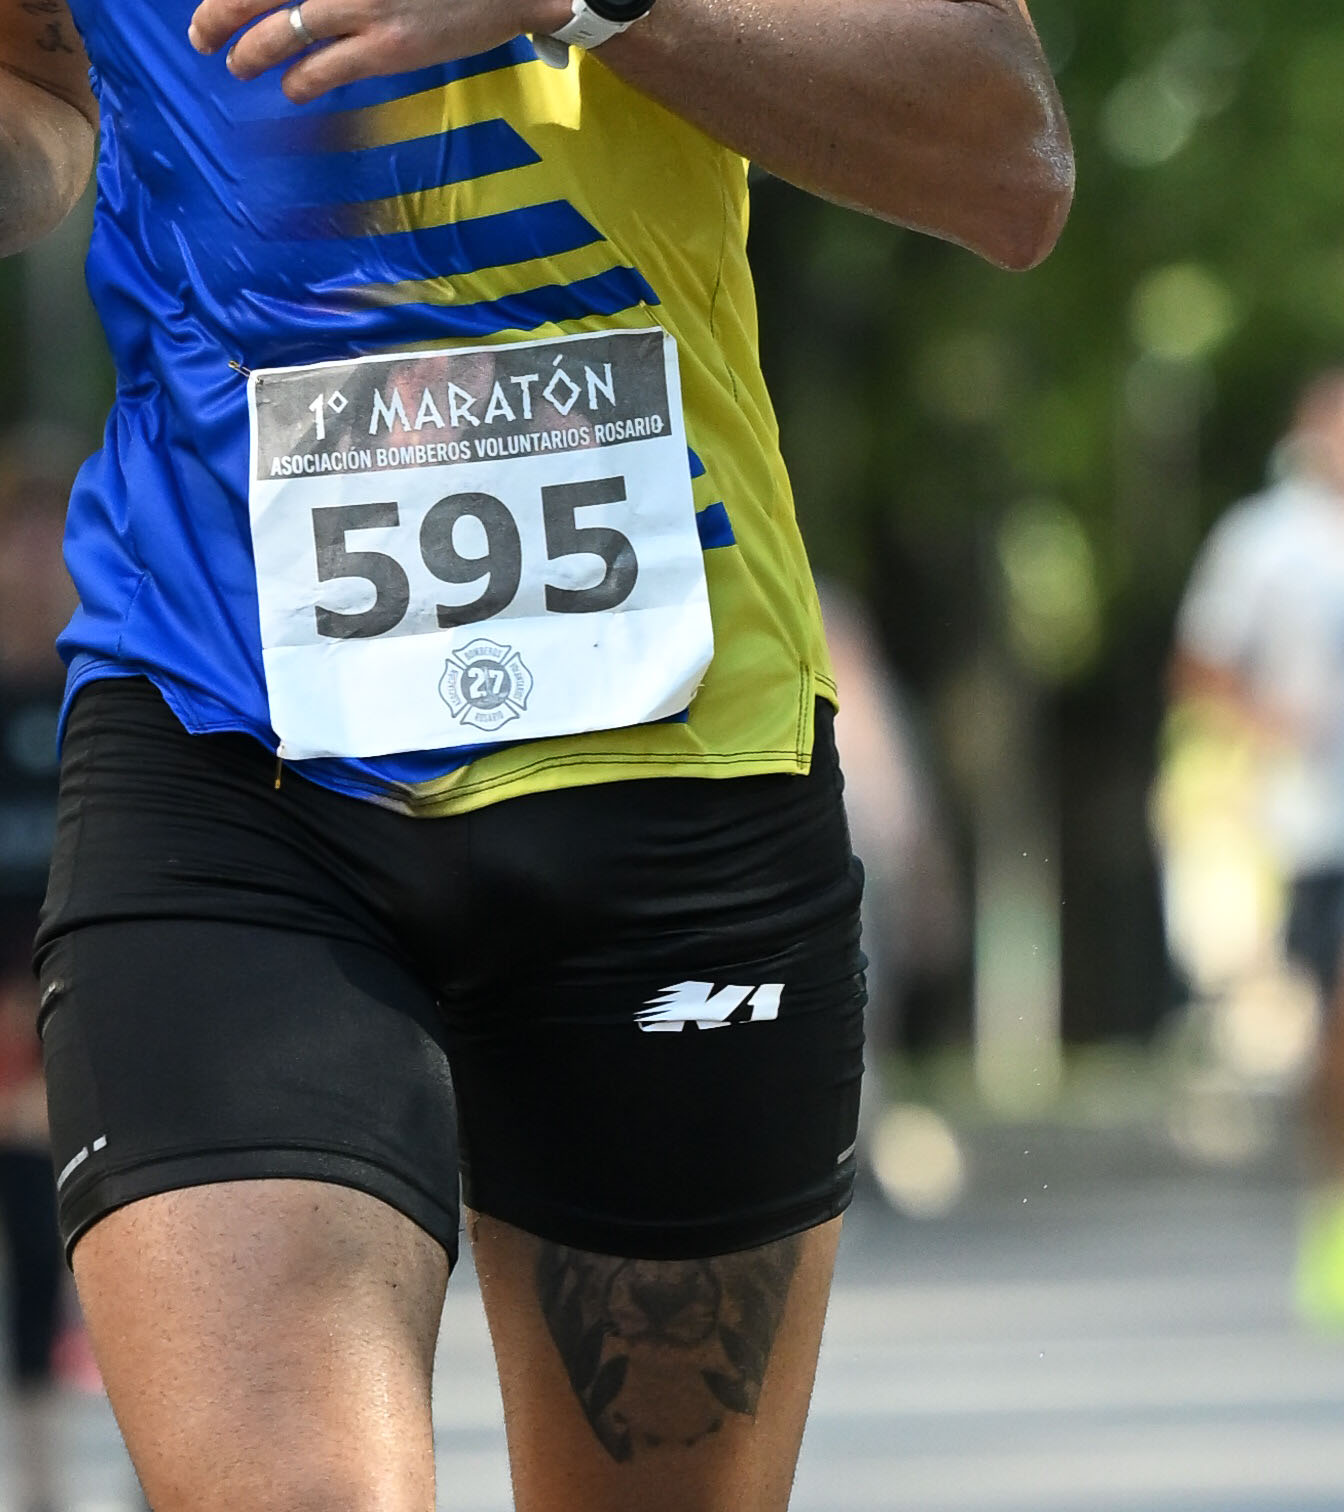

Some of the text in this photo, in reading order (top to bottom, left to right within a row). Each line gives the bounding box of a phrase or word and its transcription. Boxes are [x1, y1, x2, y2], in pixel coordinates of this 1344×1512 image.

[369, 354, 617, 435] MARATÓN
[270, 414, 665, 476] ASOCIACIÓN BOMBEROS VOLUNTARIOS ROSARIO
[311, 475, 639, 640] 595
[467, 668, 504, 699] 27
[634, 981, 785, 1033] K1
